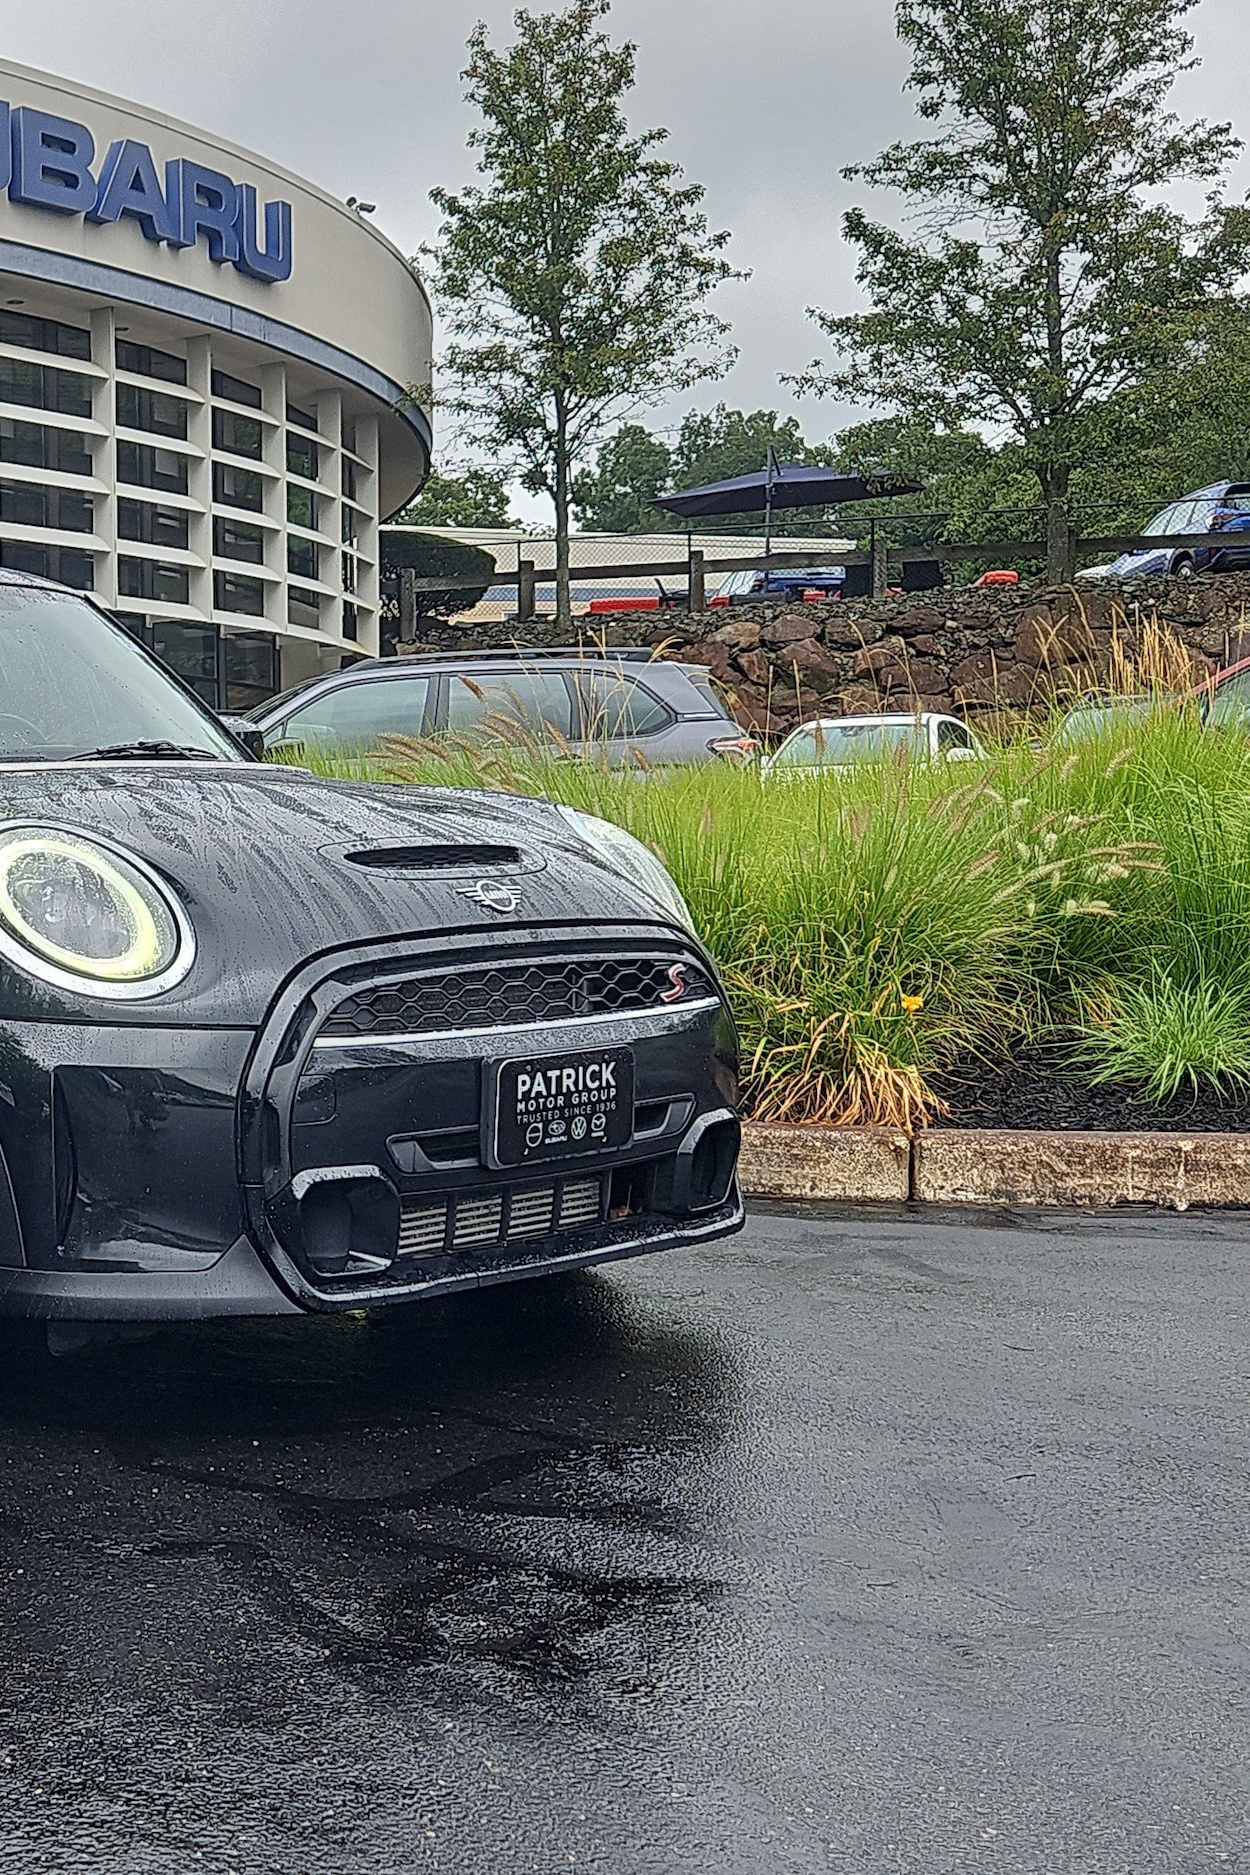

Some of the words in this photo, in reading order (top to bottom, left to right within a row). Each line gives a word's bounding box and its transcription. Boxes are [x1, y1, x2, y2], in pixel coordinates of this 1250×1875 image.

[659, 963, 686, 1003] S
[517, 1061, 617, 1100] PATRICK
[516, 1095, 565, 1114] MOTOR
[571, 1087, 617, 1105] GROUP
[516, 1109, 561, 1125] TRUSTED
[564, 1104, 592, 1118] SINCE
[595, 1100, 617, 1113] 1936
